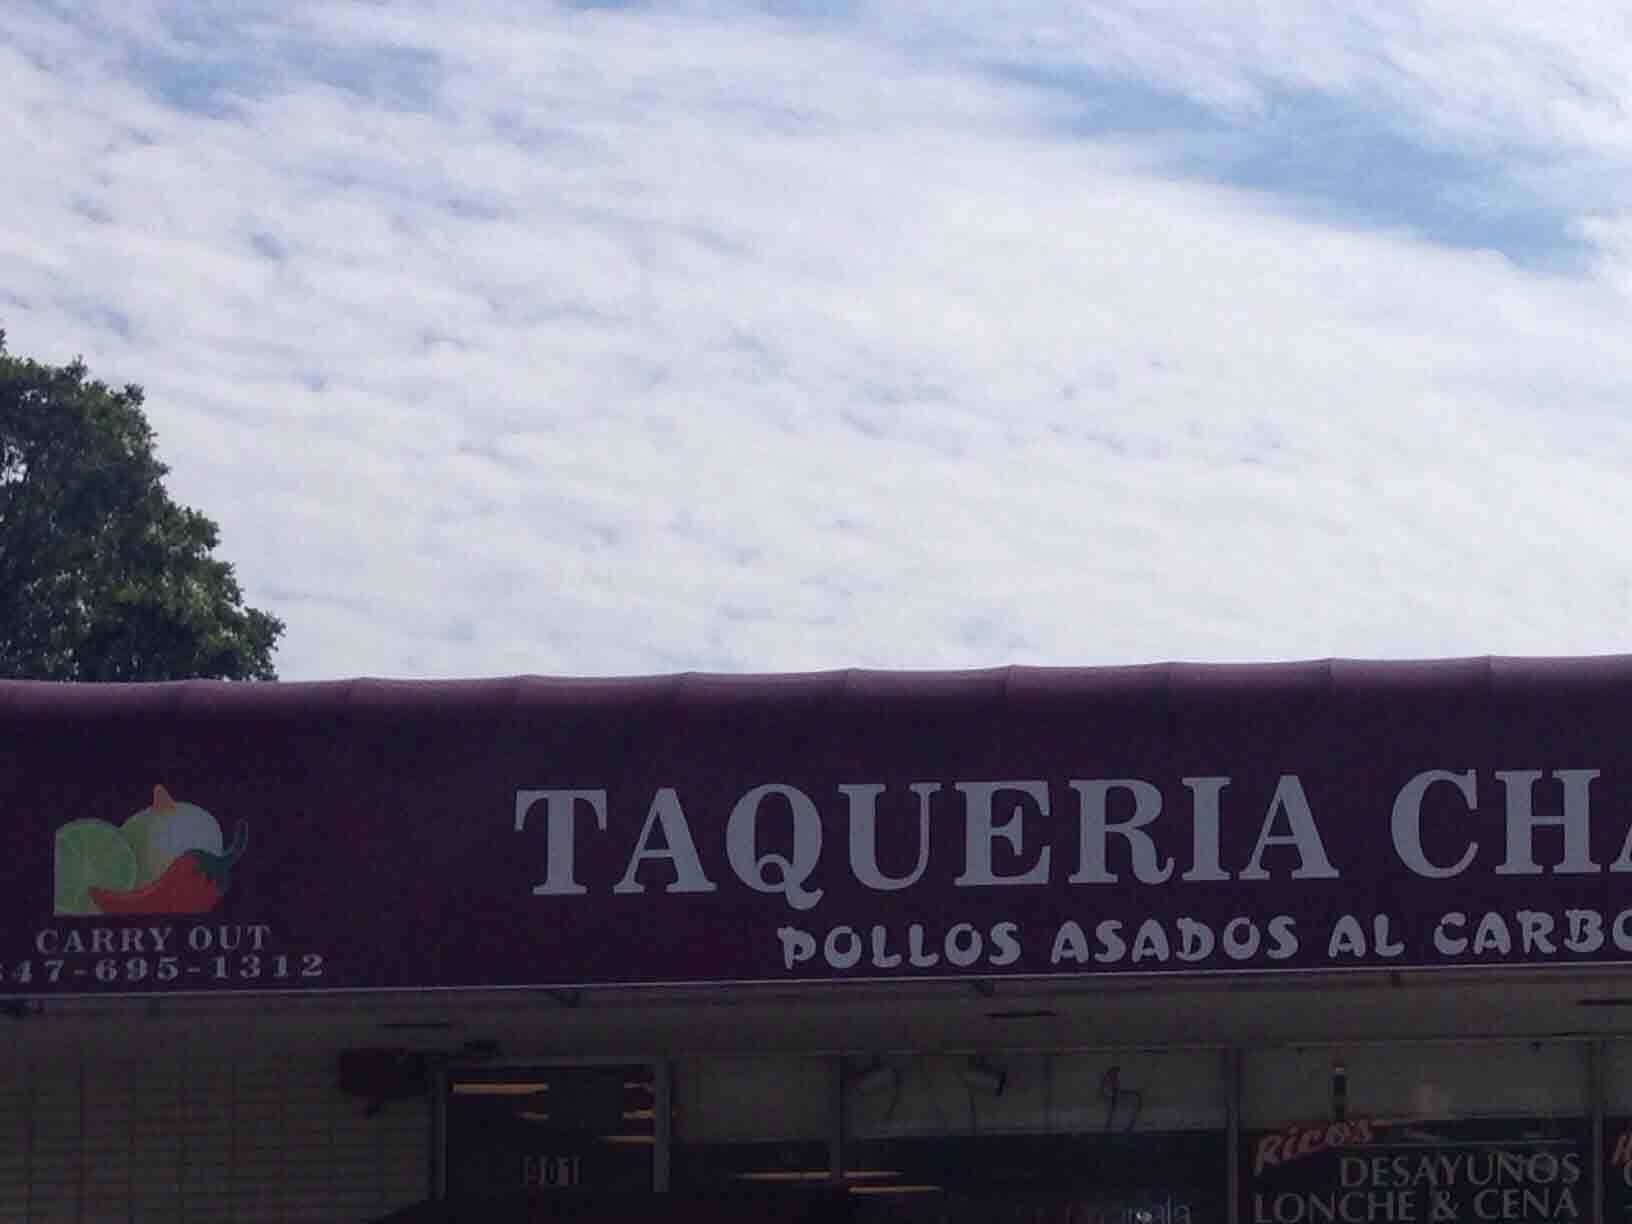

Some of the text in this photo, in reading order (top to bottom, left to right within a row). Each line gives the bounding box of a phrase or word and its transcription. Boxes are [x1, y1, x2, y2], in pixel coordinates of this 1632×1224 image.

[513, 773, 1340, 911] TAQUERIA
[34, 923, 273, 954] CARRY OUT
[776, 918, 1022, 971] POLLOS
[1050, 913, 1300, 966] ASADOS
[1327, 912, 1407, 960] AL
[0, 952, 328, 984] 47-695-1312
[1339, 1151, 1584, 1189] DESAYUNOS
[1254, 1187, 1581, 1224] LONCHE & CENA
